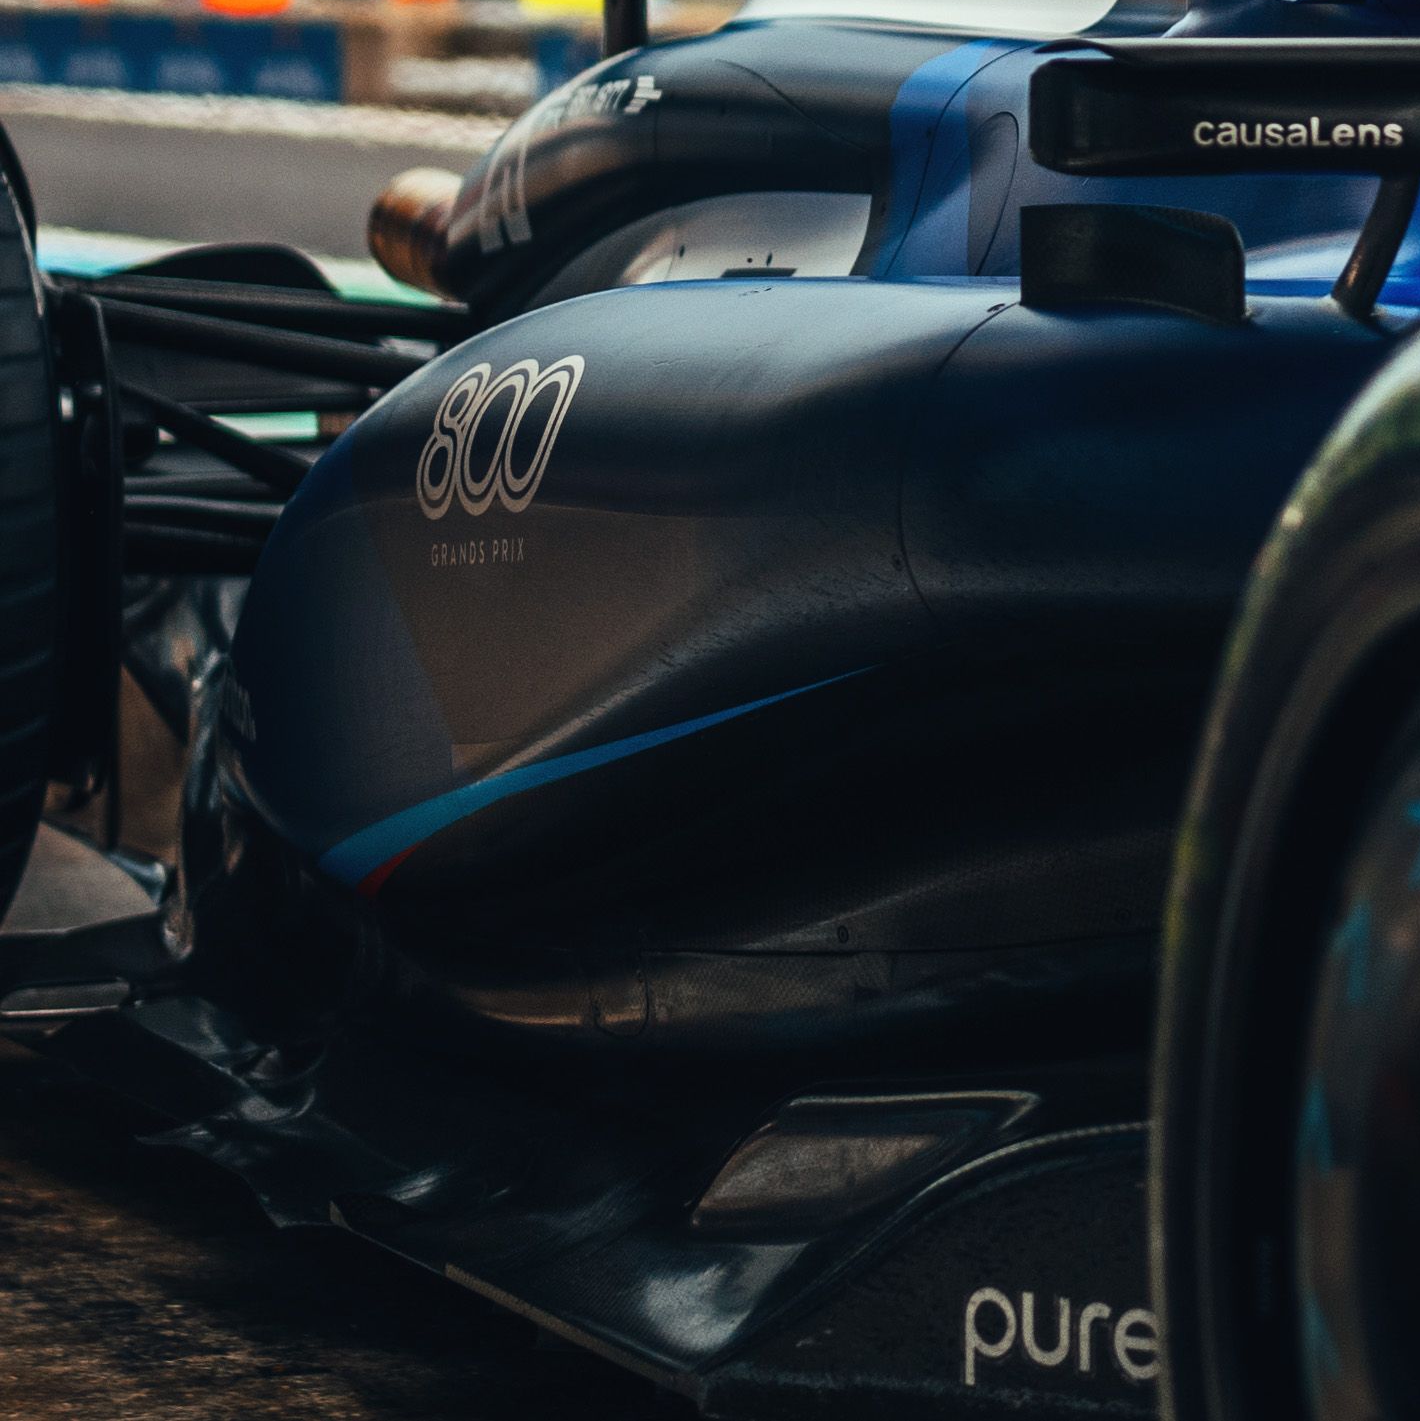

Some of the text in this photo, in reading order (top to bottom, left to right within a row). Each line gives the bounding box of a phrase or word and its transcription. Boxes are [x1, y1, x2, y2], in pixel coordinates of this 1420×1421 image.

[1192, 115, 1405, 148] causaLens
[416, 354, 585, 521] 800
[431, 537, 525, 567] GRANDS PRIX
